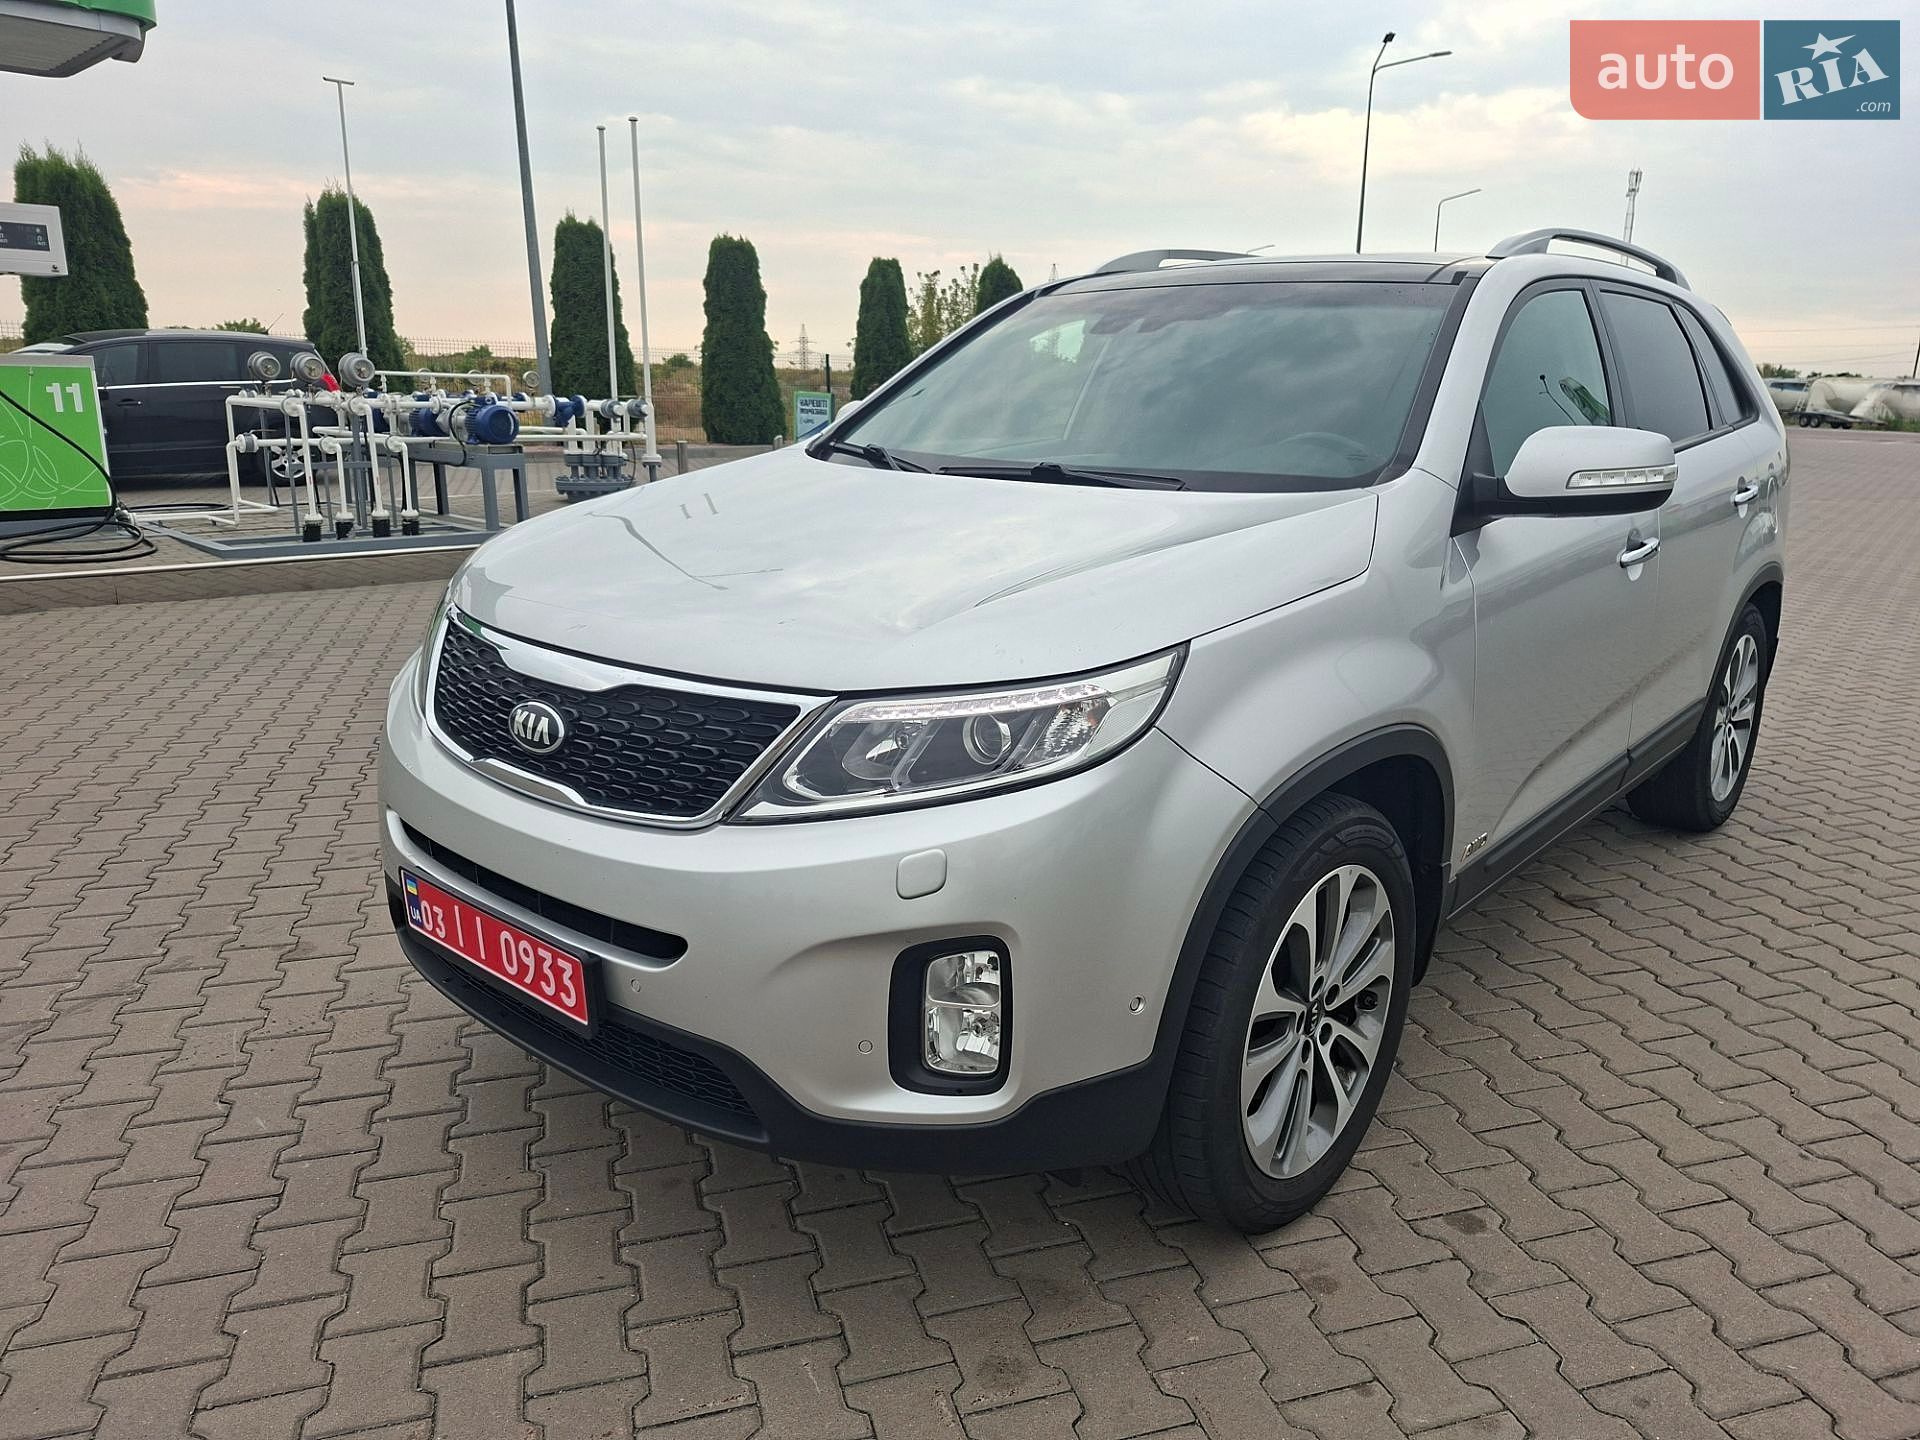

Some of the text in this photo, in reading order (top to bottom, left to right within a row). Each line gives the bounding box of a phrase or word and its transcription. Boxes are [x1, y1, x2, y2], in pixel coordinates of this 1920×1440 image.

[46, 383, 83, 412] 11
[514, 709, 550, 745] KIA
[410, 905, 422, 923] UA
[420, 900, 446, 939] 03
[500, 930, 577, 1008] 0933
